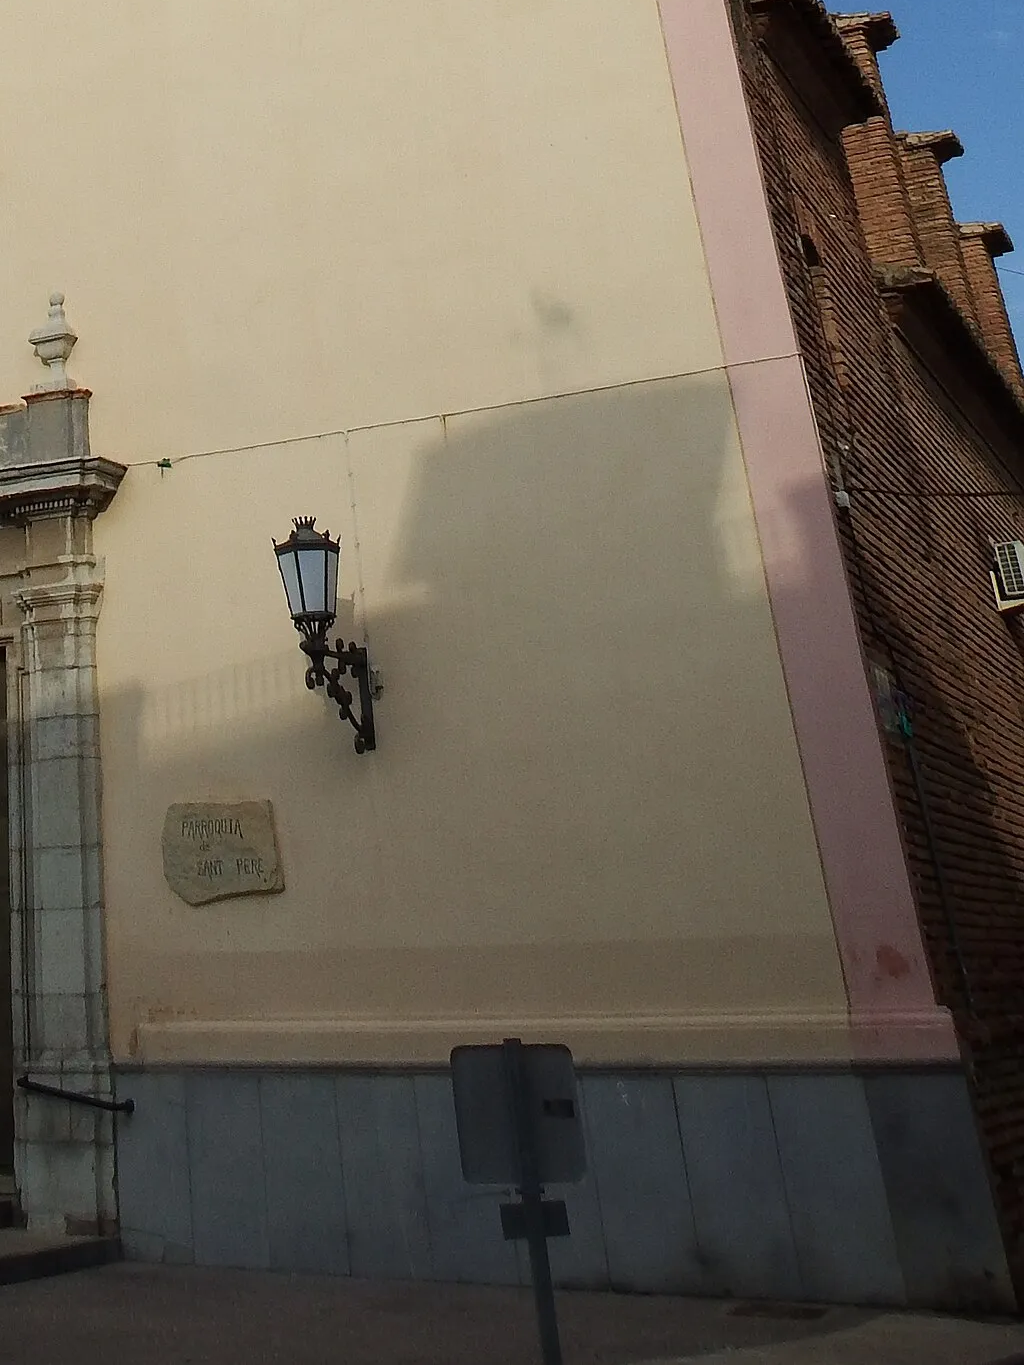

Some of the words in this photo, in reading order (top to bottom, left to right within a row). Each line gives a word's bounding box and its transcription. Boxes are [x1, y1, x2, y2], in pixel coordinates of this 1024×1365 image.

[181, 818, 243, 840] PARROQUIA
[199, 840, 211, 851] de
[197, 859, 223, 881] SANT
[236, 857, 264, 878] PERE
